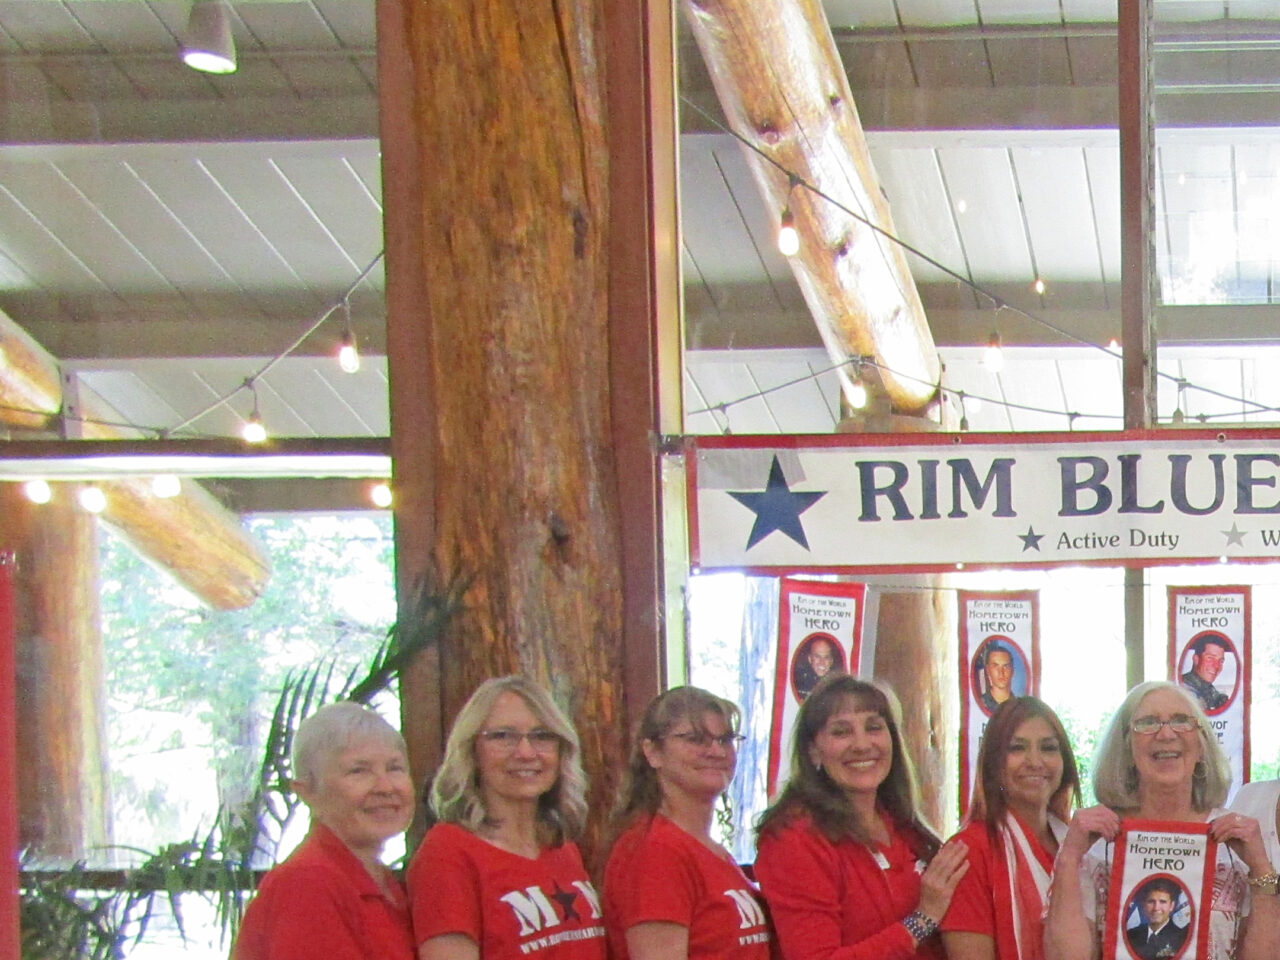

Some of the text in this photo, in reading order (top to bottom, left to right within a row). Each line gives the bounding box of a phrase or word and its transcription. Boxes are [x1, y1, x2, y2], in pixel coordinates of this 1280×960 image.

[855, 456, 1018, 522] RIM
[1055, 529, 1179, 552] Active Duty
[793, 605, 851, 618] HOMETOWN
[969, 610, 1029, 619] HOMETOWN
[1179, 605, 1241, 615] HOMETOWN
[804, 618, 841, 631] HERO
[980, 622, 1016, 632] HERO
[1191, 617, 1229, 628] HERO
[1130, 844, 1201, 857] HOMETOWN
[1142, 857, 1185, 871] HERO
